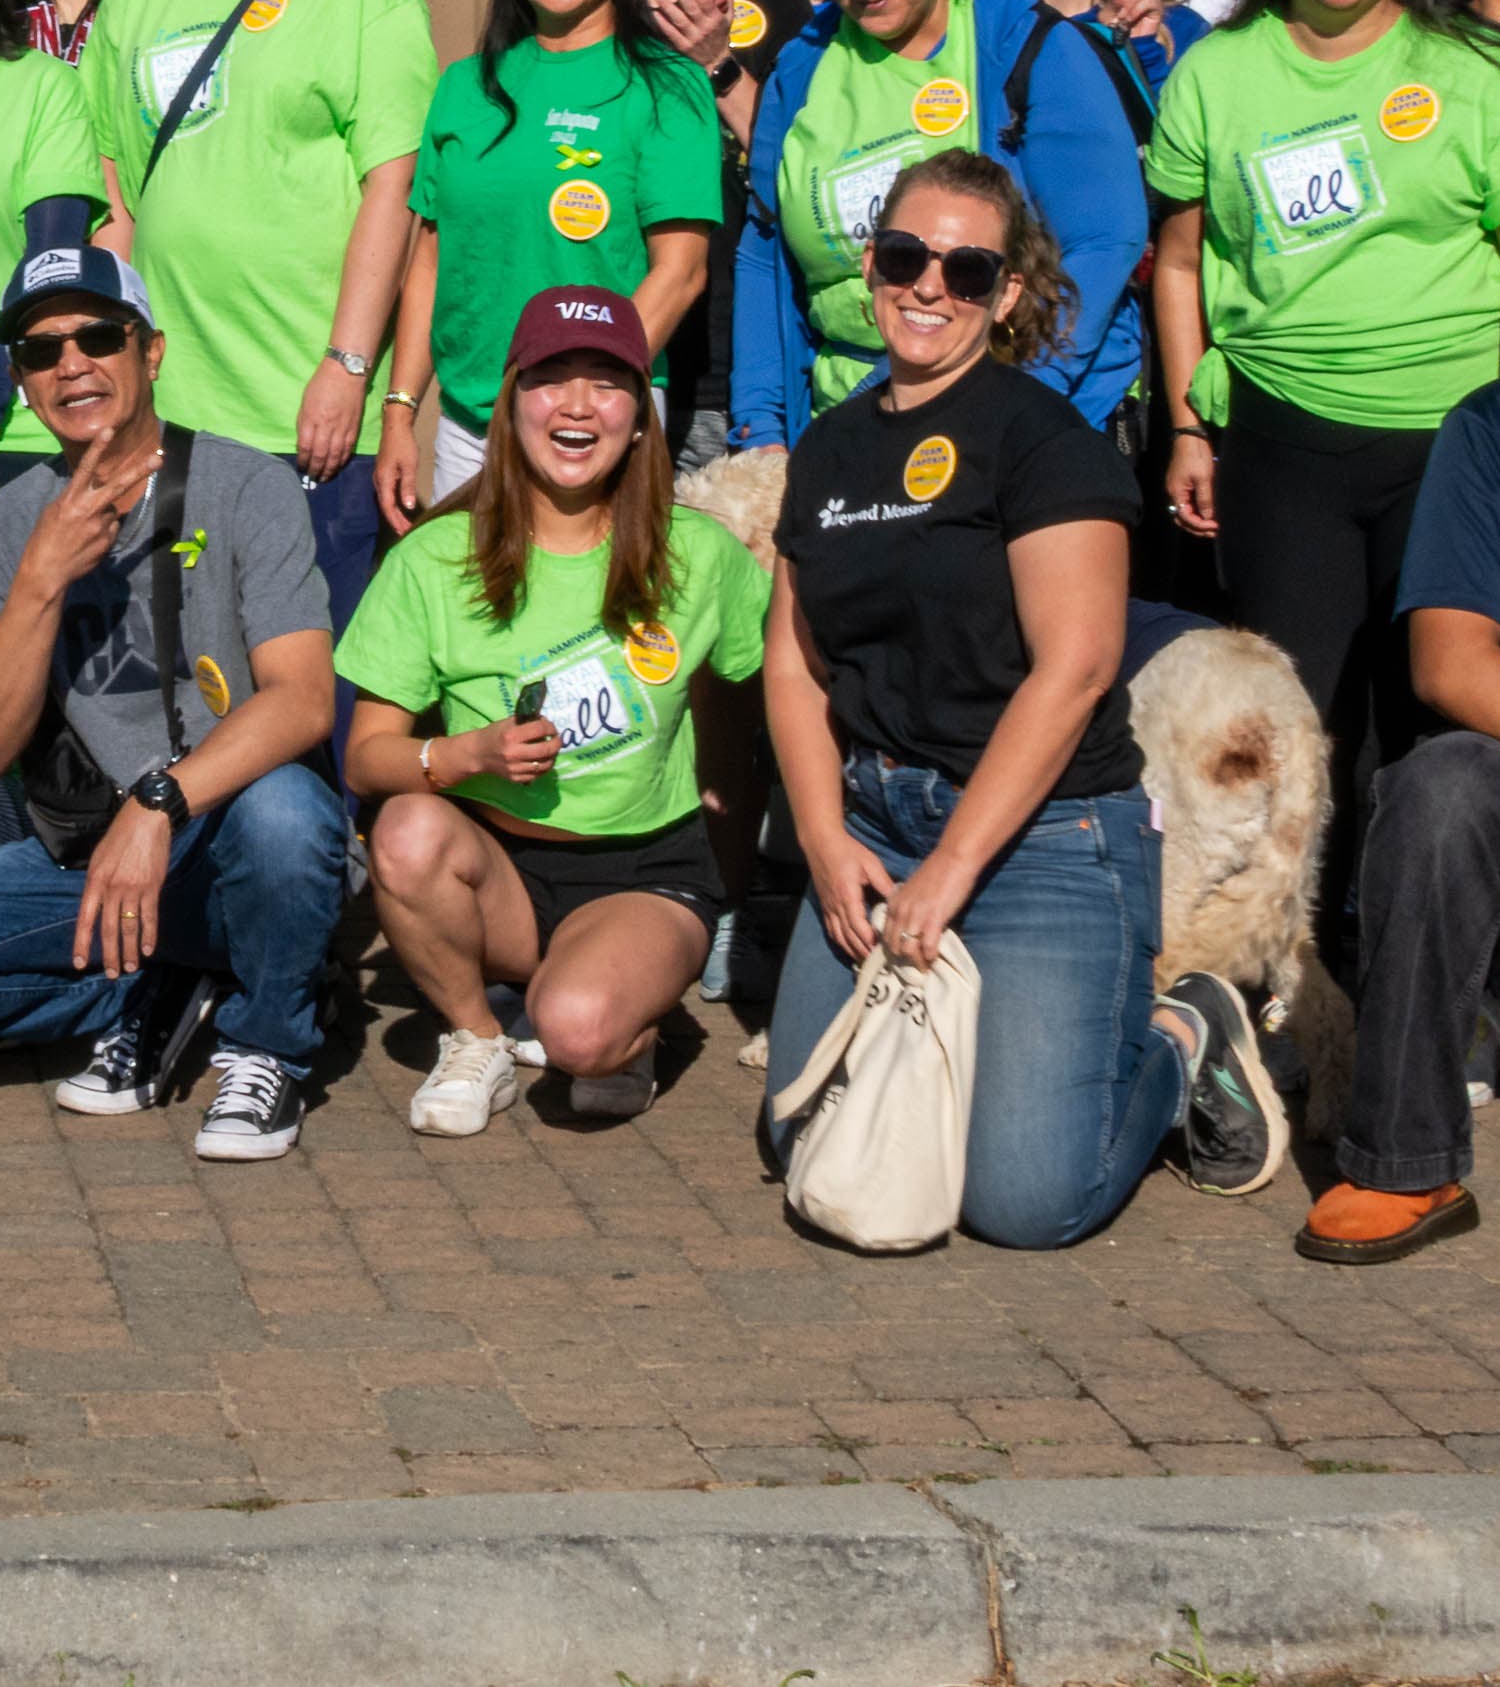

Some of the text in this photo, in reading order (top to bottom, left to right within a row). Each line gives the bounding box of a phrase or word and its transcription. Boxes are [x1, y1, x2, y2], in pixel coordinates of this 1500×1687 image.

[1289, 168, 1354, 222] all
[554, 301, 615, 324] VISA
[560, 686, 624, 750] all
